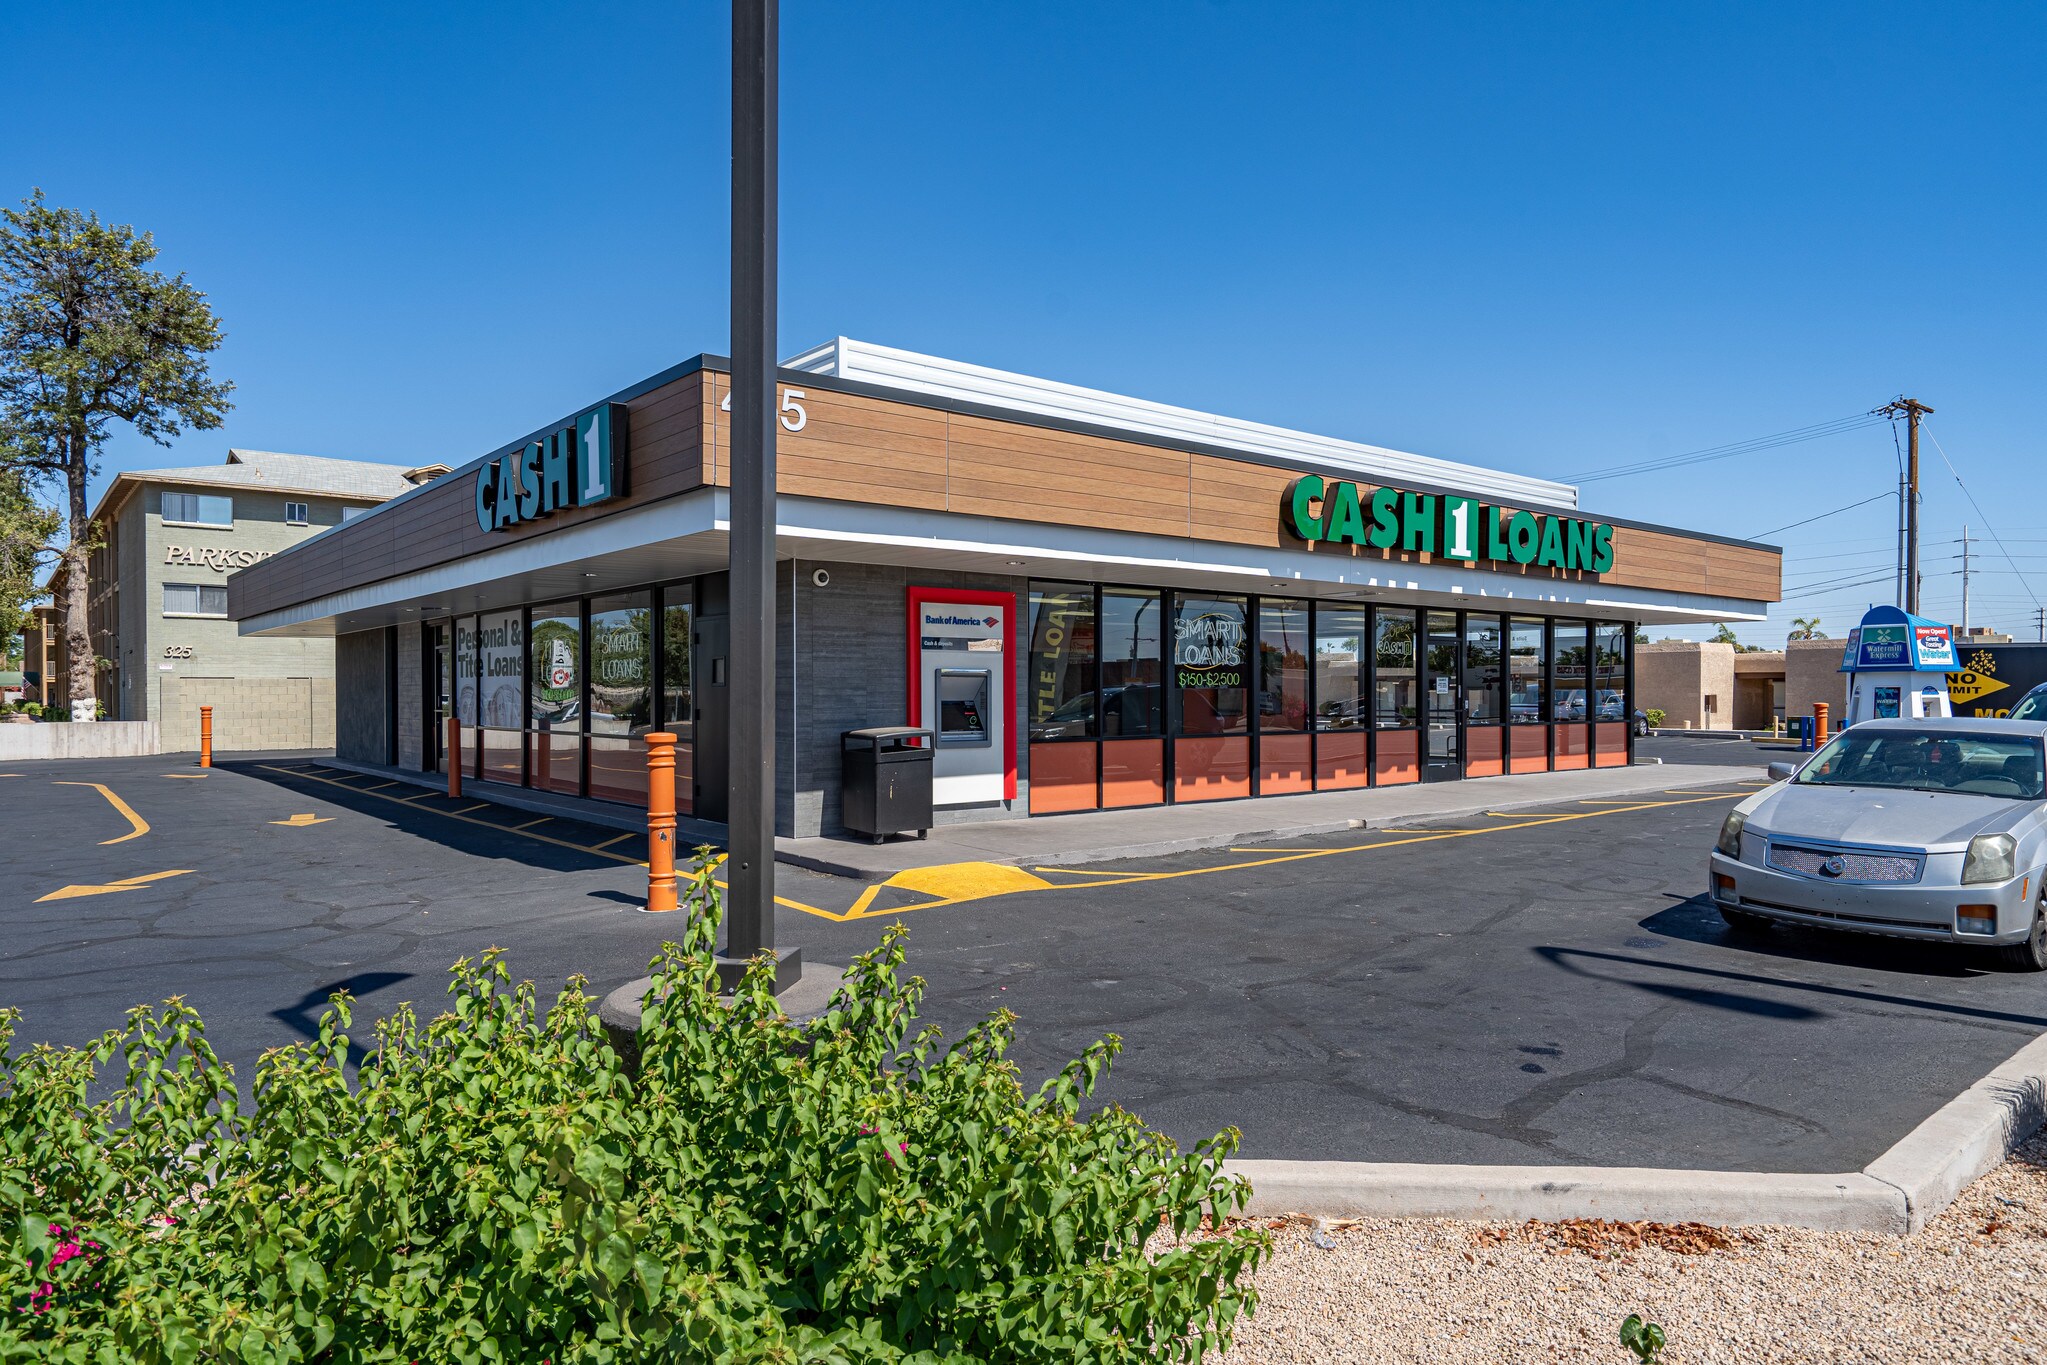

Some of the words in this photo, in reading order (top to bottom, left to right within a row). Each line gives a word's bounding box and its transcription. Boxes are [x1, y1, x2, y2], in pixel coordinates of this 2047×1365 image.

[475, 428, 570, 534] CASH
[584, 413, 605, 500] 1
[1292, 474, 1435, 553] CASH
[1450, 501, 1472, 557] 1
[1489, 506, 1614, 574] LOANS
[164, 545, 278, 573] PARKSI
[926, 615, 944, 624] Bank
[944, 616, 952, 624] of
[952, 616, 981, 626] America
[1175, 618, 1242, 640] SMART
[511, 620, 522, 646] &
[1389, 623, 1411, 637] Open
[601, 632, 642, 653] SMART
[1377, 641, 1404, 654] CASH
[1867, 645, 1902, 653] Watermill
[164, 646, 193, 659] 325
[1175, 645, 1241, 667] LOANS
[1870, 652, 1899, 660] Express
[1919, 649, 1951, 659] Water
[487, 652, 522, 677] Loans
[602, 657, 642, 679] LOANS
[1179, 671, 1240, 688] $150-$2,500
[1944, 673, 1977, 684] NO
[1948, 686, 1982, 694] IMIT
